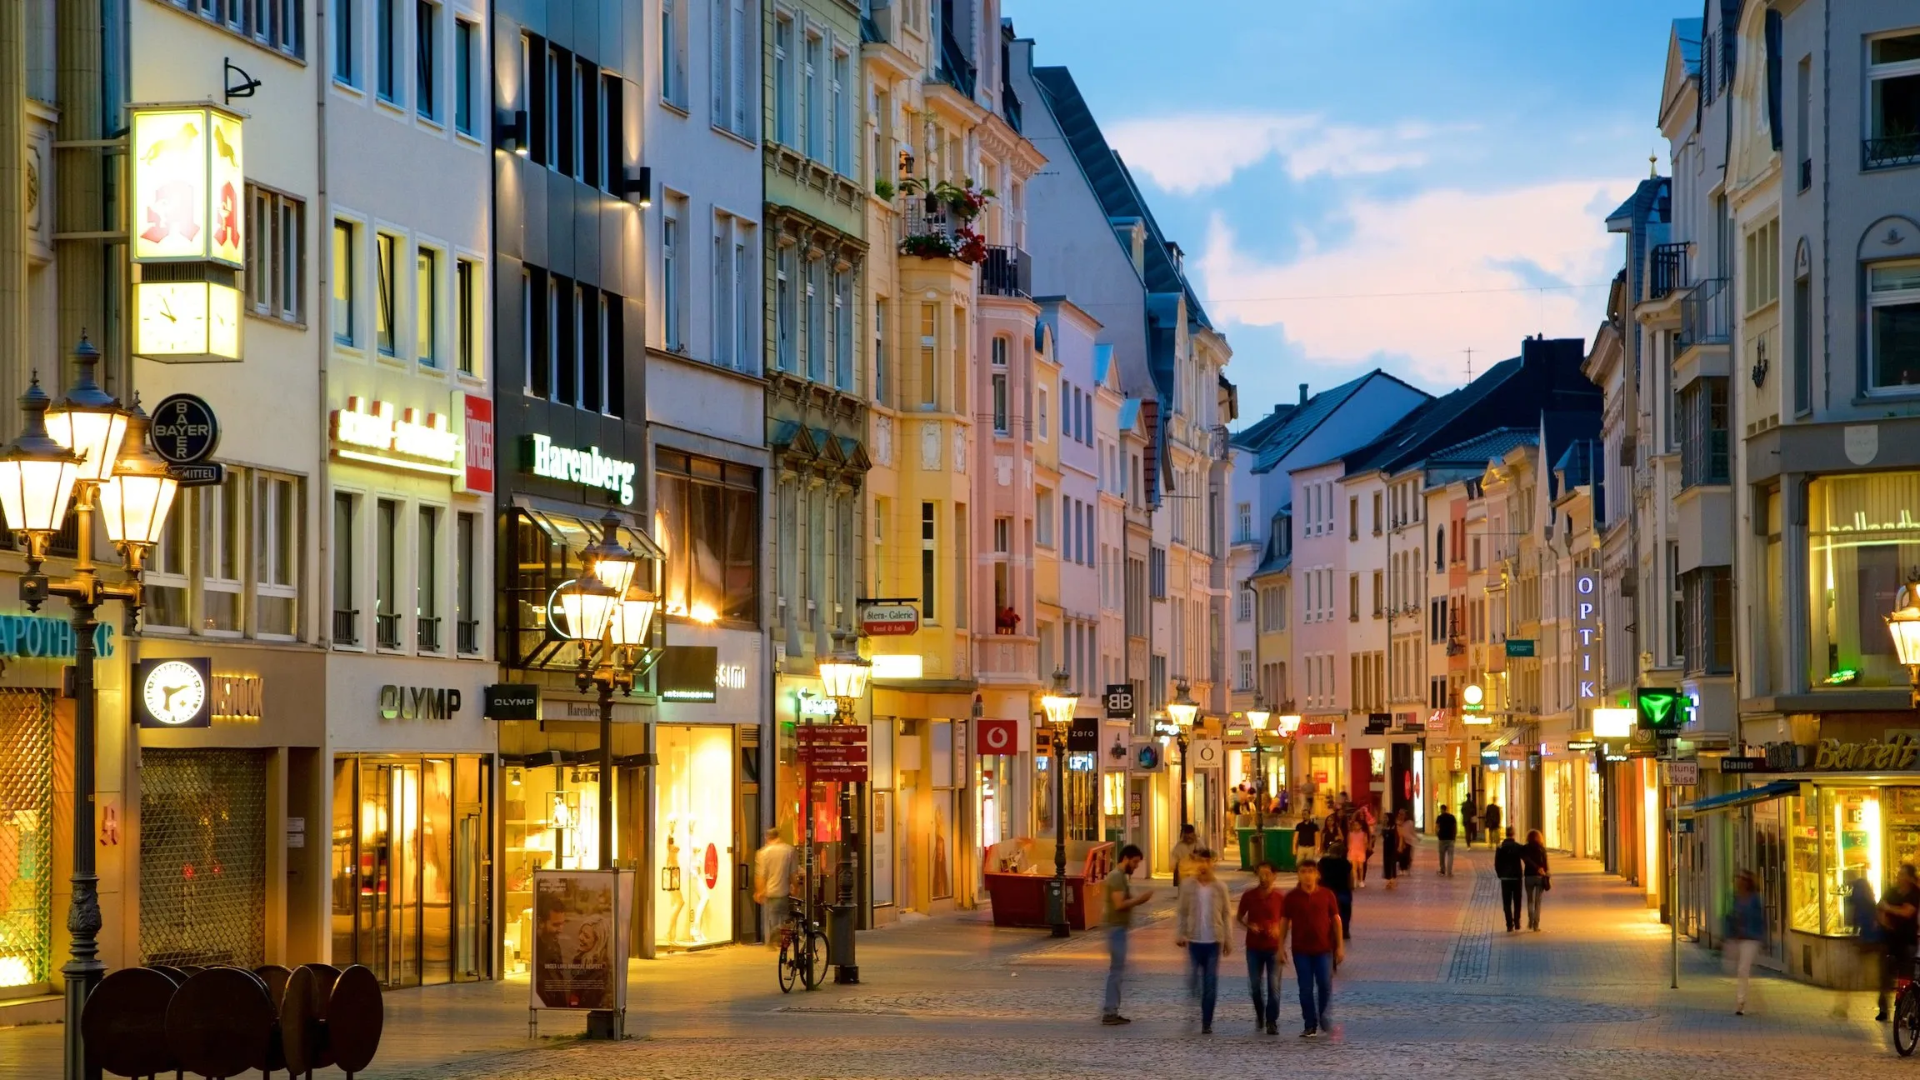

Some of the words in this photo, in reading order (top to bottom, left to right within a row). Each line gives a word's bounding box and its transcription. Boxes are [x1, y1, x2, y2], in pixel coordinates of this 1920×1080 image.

[155, 424, 209, 436] BAYER
[176, 402, 188, 458] BAYER
[532, 432, 636, 506] Harenberg
[0, 615, 114, 658] APOTHKE
[1578, 577, 1594, 698] OPTIK
[380, 684, 461, 720] OLYMP
[494, 698, 534, 706] OLYMP
[567, 702, 600, 717] Harenber
[1072, 730, 1095, 738] zero
[1722, 759, 1754, 770] Game
